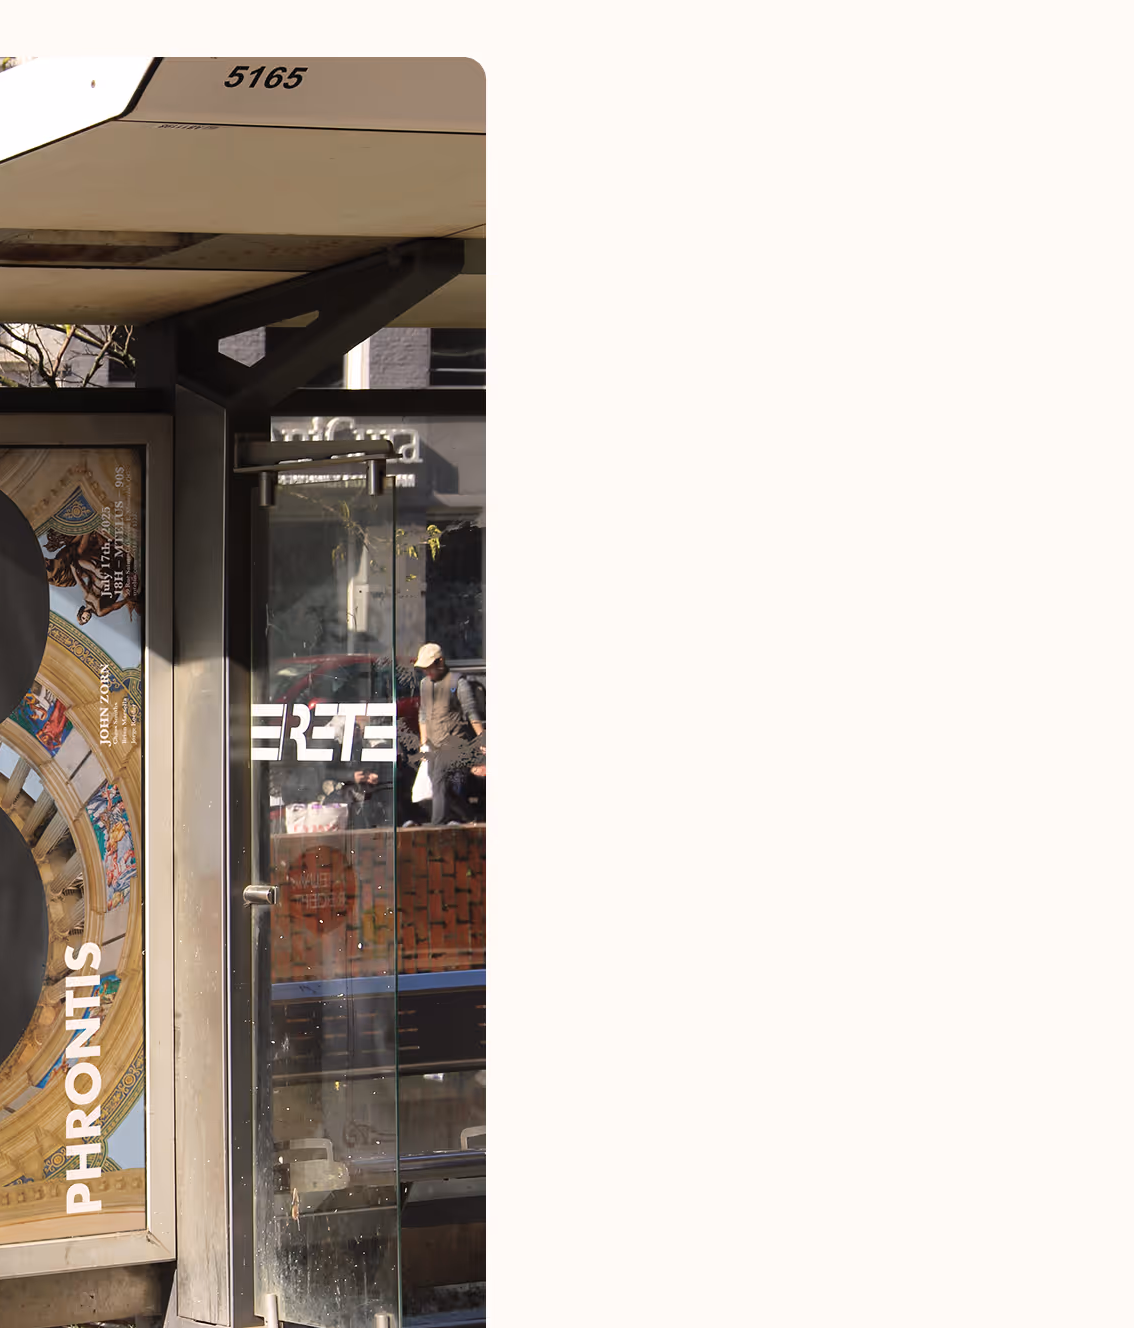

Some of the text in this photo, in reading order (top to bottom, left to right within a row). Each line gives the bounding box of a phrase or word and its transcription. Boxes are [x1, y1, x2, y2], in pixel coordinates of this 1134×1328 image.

[224, 65, 308, 89] 5165
[115, 466, 125, 488] 90$
[100, 506, 113, 598] July 17th, 2025
[114, 501, 124, 557] MTELUS
[113, 570, 124, 595] 18H
[100, 664, 112, 747] JOHN ZORN
[65, 942, 102, 1214] PHRONTIS
